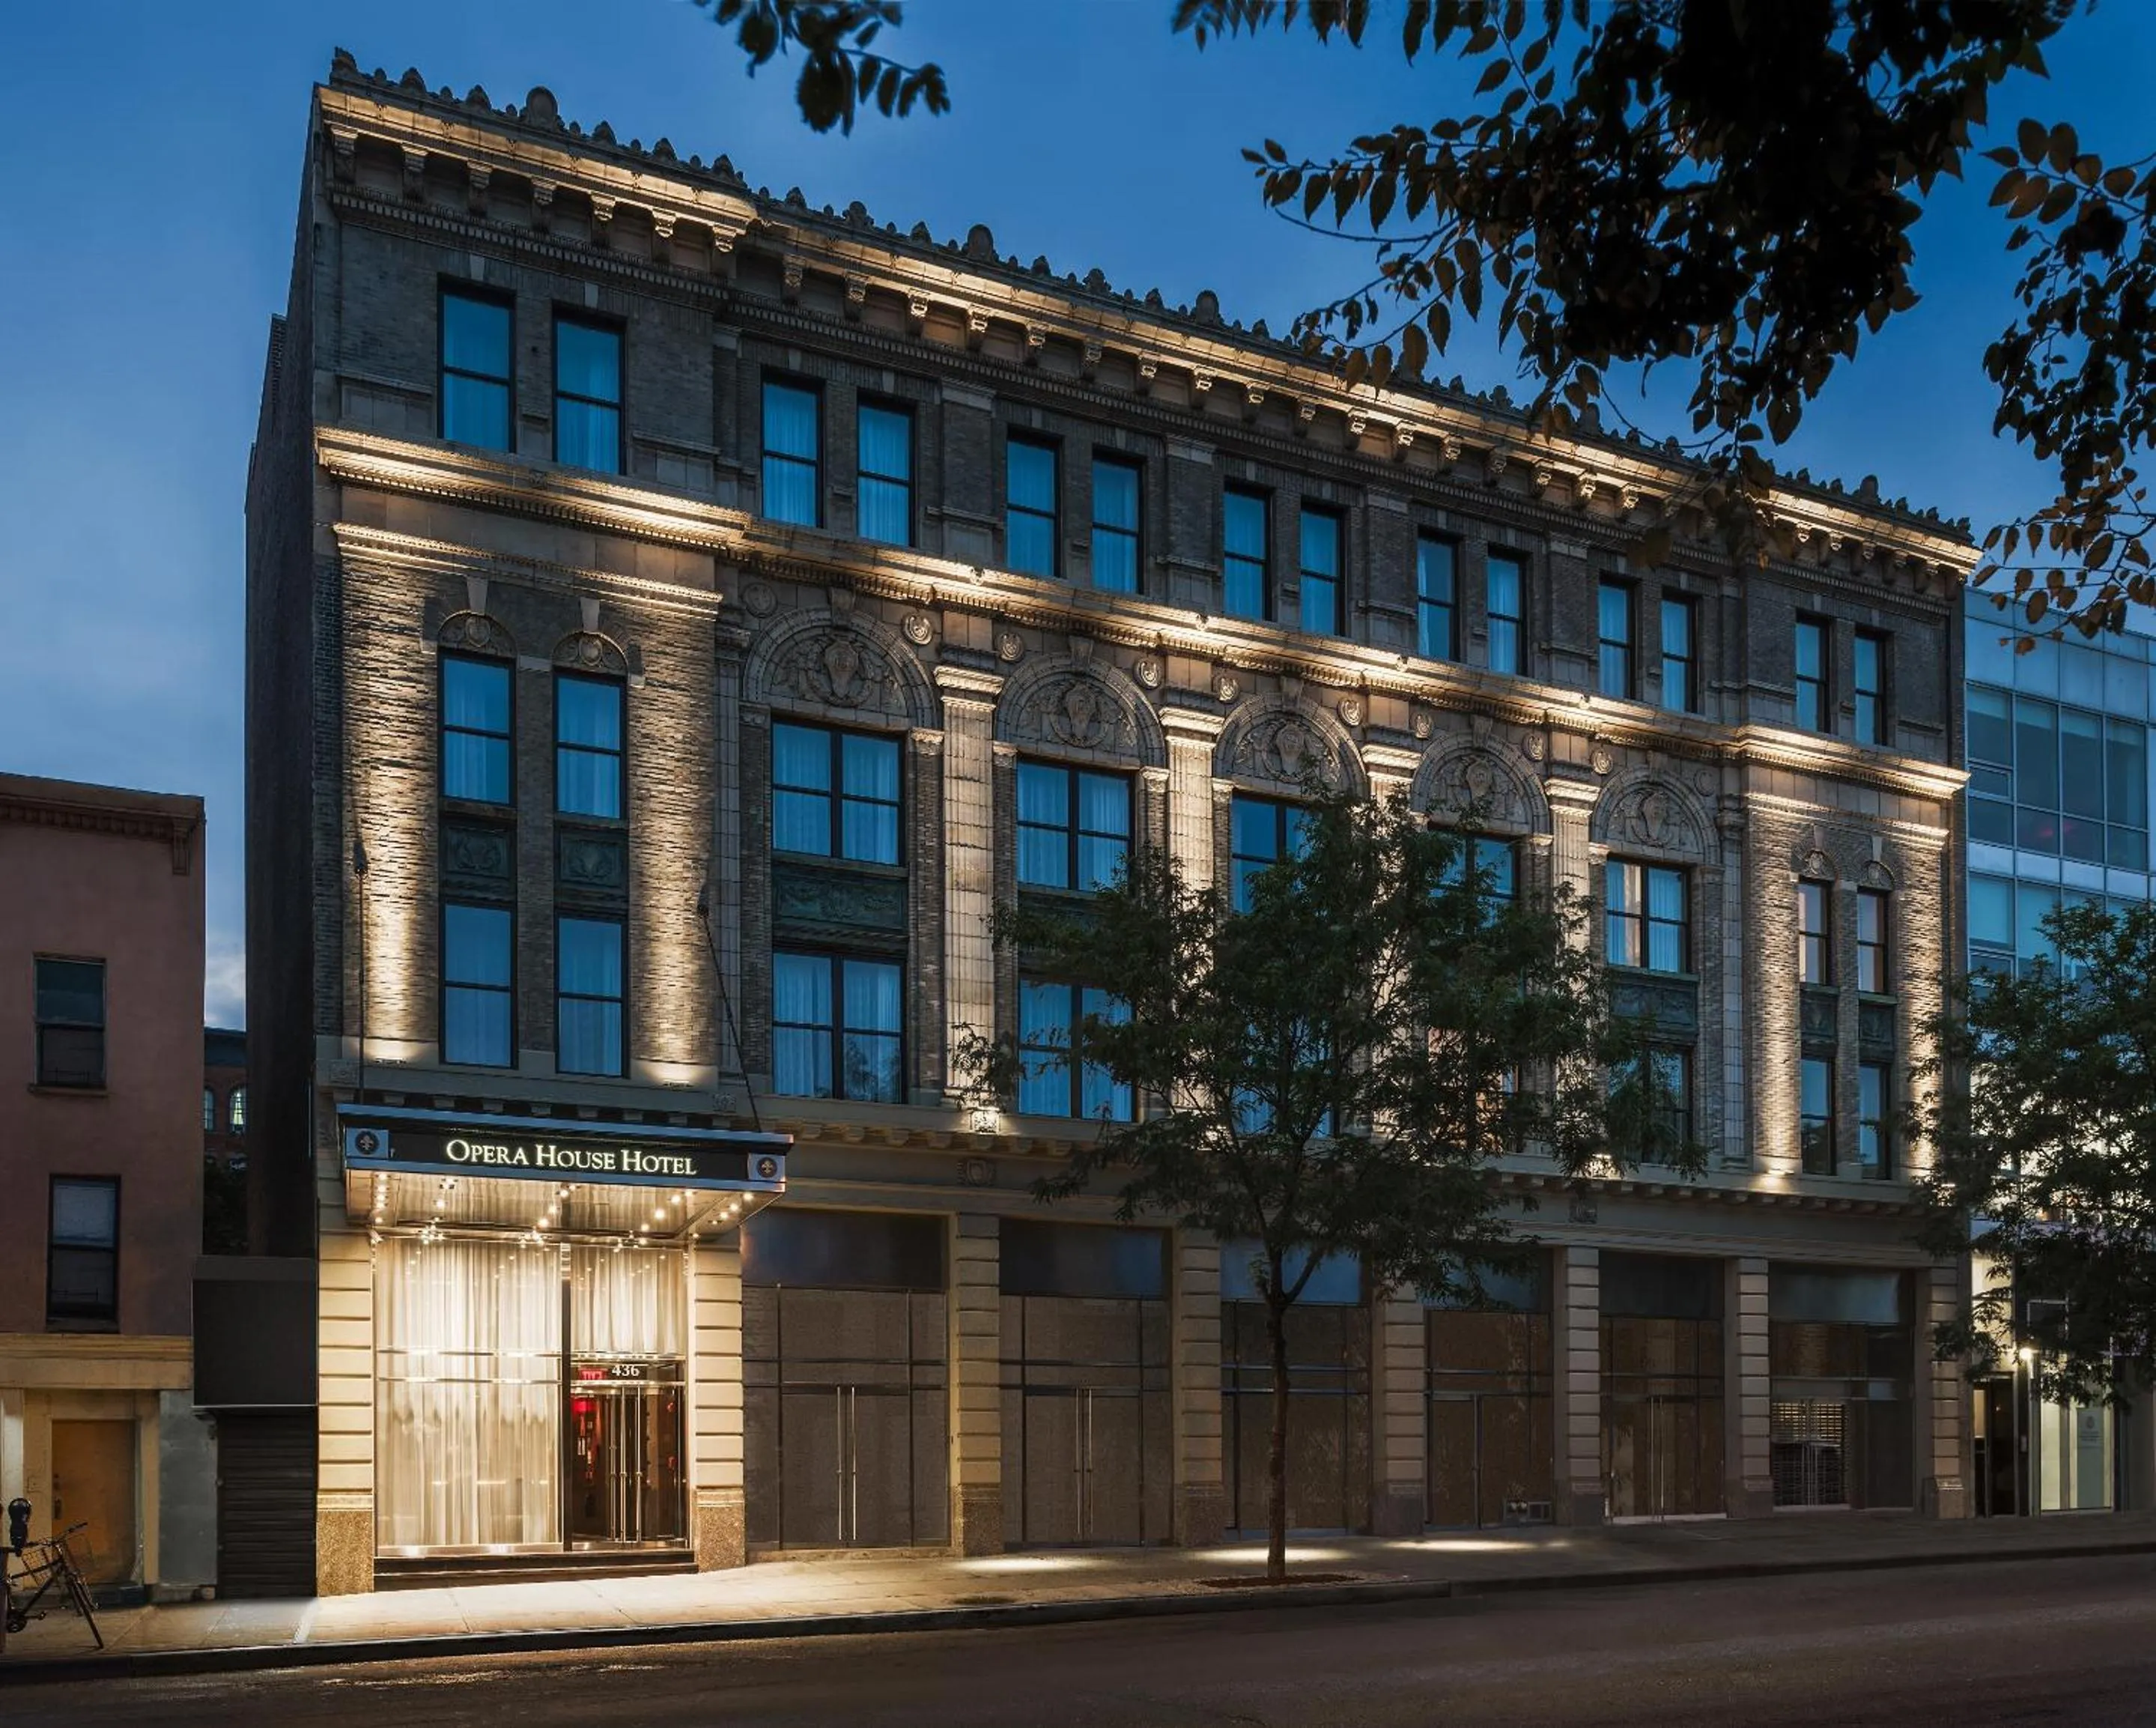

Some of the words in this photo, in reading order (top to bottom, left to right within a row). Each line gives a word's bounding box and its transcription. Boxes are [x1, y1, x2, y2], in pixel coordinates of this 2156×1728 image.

[446, 1139, 529, 1165] OPERA
[535, 1144, 616, 1170] HOUSE
[620, 1149, 697, 1175] HOTEL
[611, 1364, 640, 1377] 436
